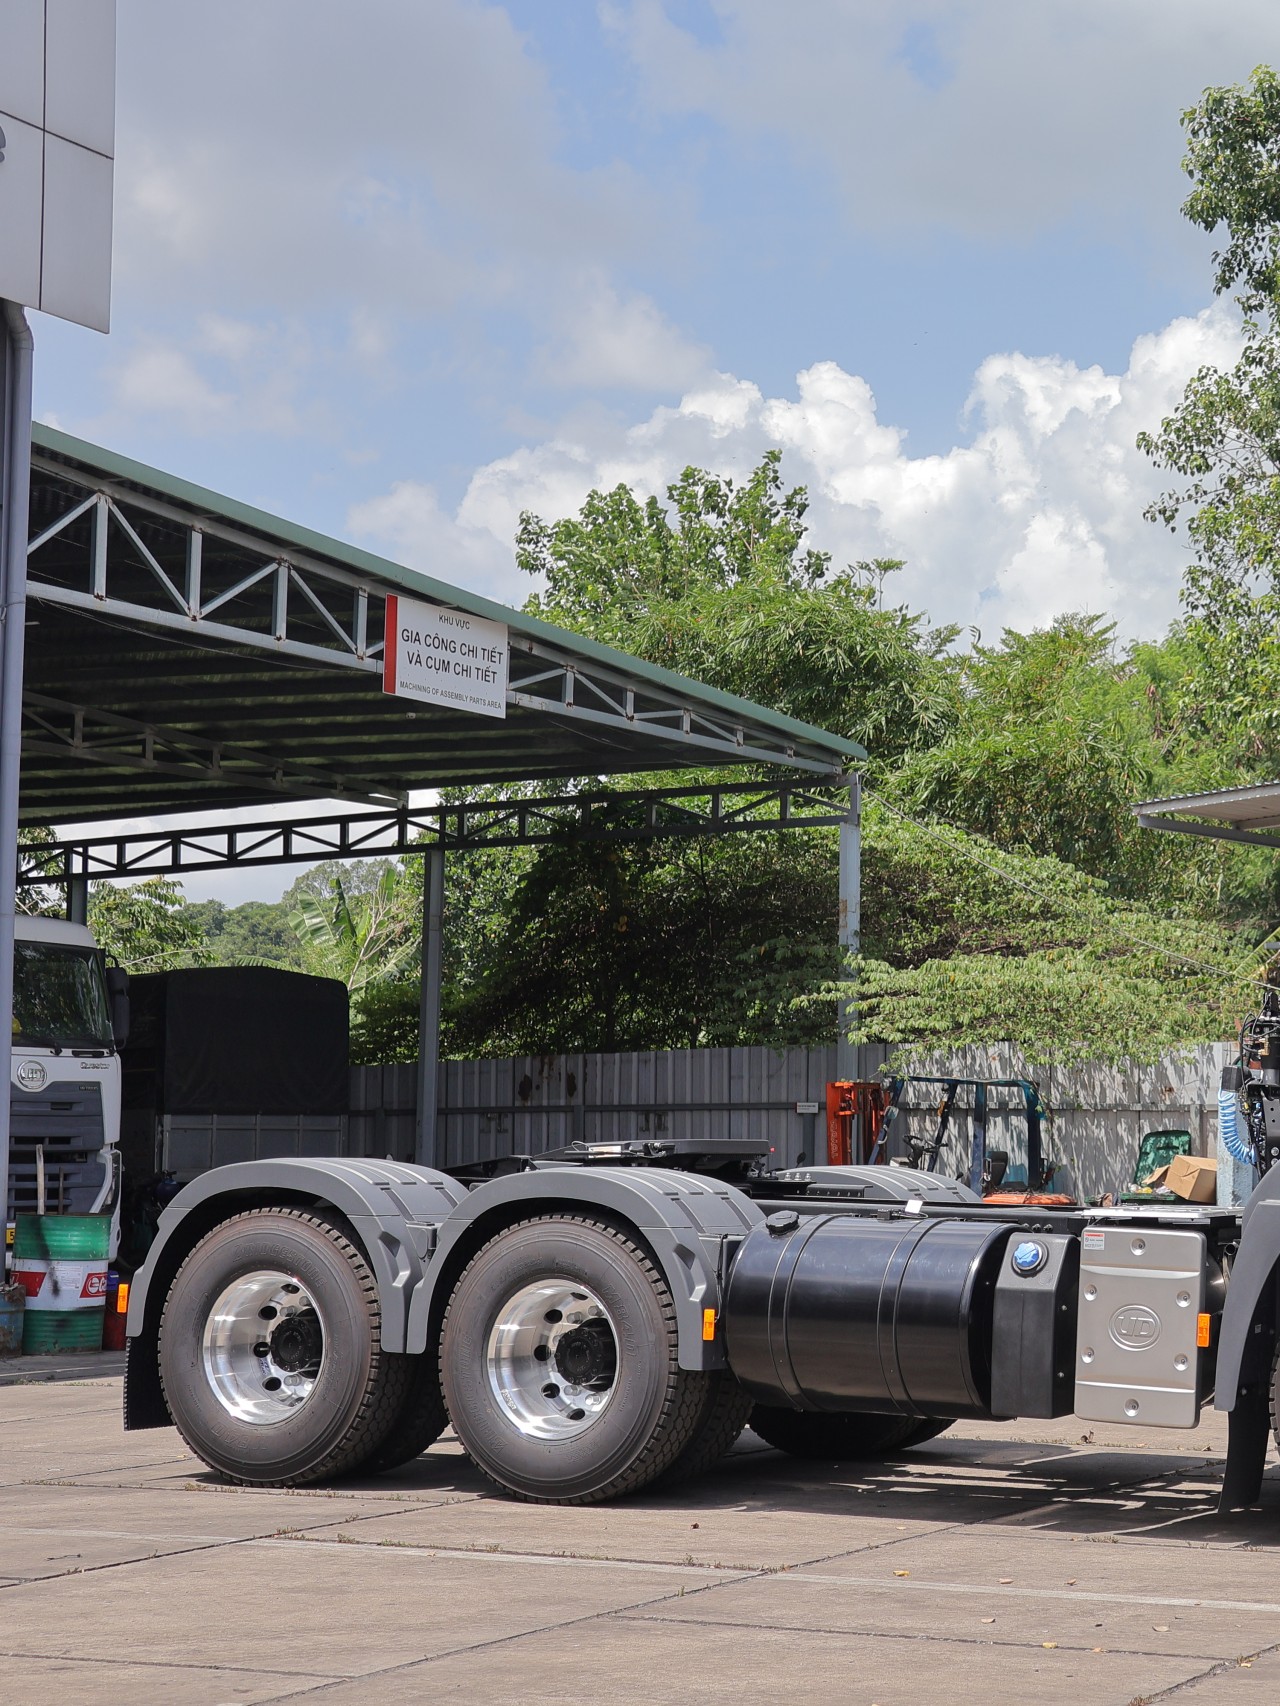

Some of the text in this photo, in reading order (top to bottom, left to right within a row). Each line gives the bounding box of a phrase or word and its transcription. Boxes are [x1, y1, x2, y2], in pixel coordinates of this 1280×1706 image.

[438, 613, 470, 630] KHU VỰC
[401, 628, 503, 665] GIA CÔNG CHI TIẾT
[407, 649, 497, 684] VÀ CỤM CHI TIẾT
[400, 680, 502, 710] MACHINING OF ASSEMBLY PARTS AREA
[1114, 1316, 1156, 1338] UD
